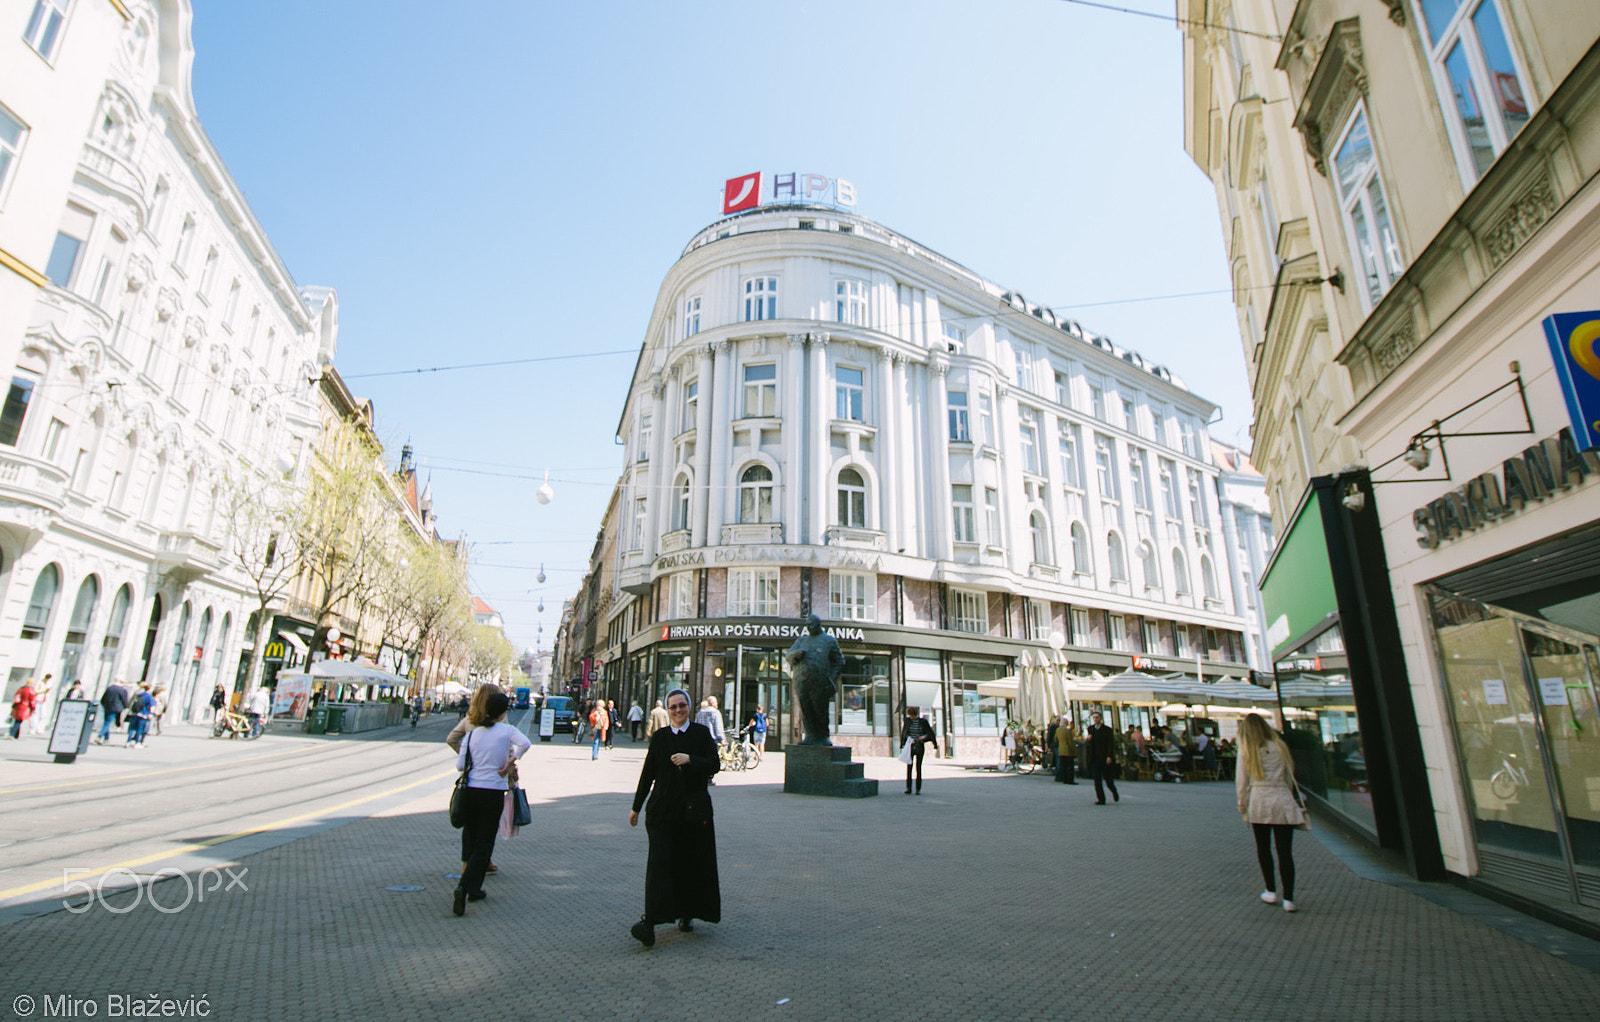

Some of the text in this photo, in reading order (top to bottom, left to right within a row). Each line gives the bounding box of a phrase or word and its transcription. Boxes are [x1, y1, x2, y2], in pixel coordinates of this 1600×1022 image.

[774, 172, 857, 206] HPB
[670, 623, 865, 640] HRVATSKA POŠTANSKA ANKA
